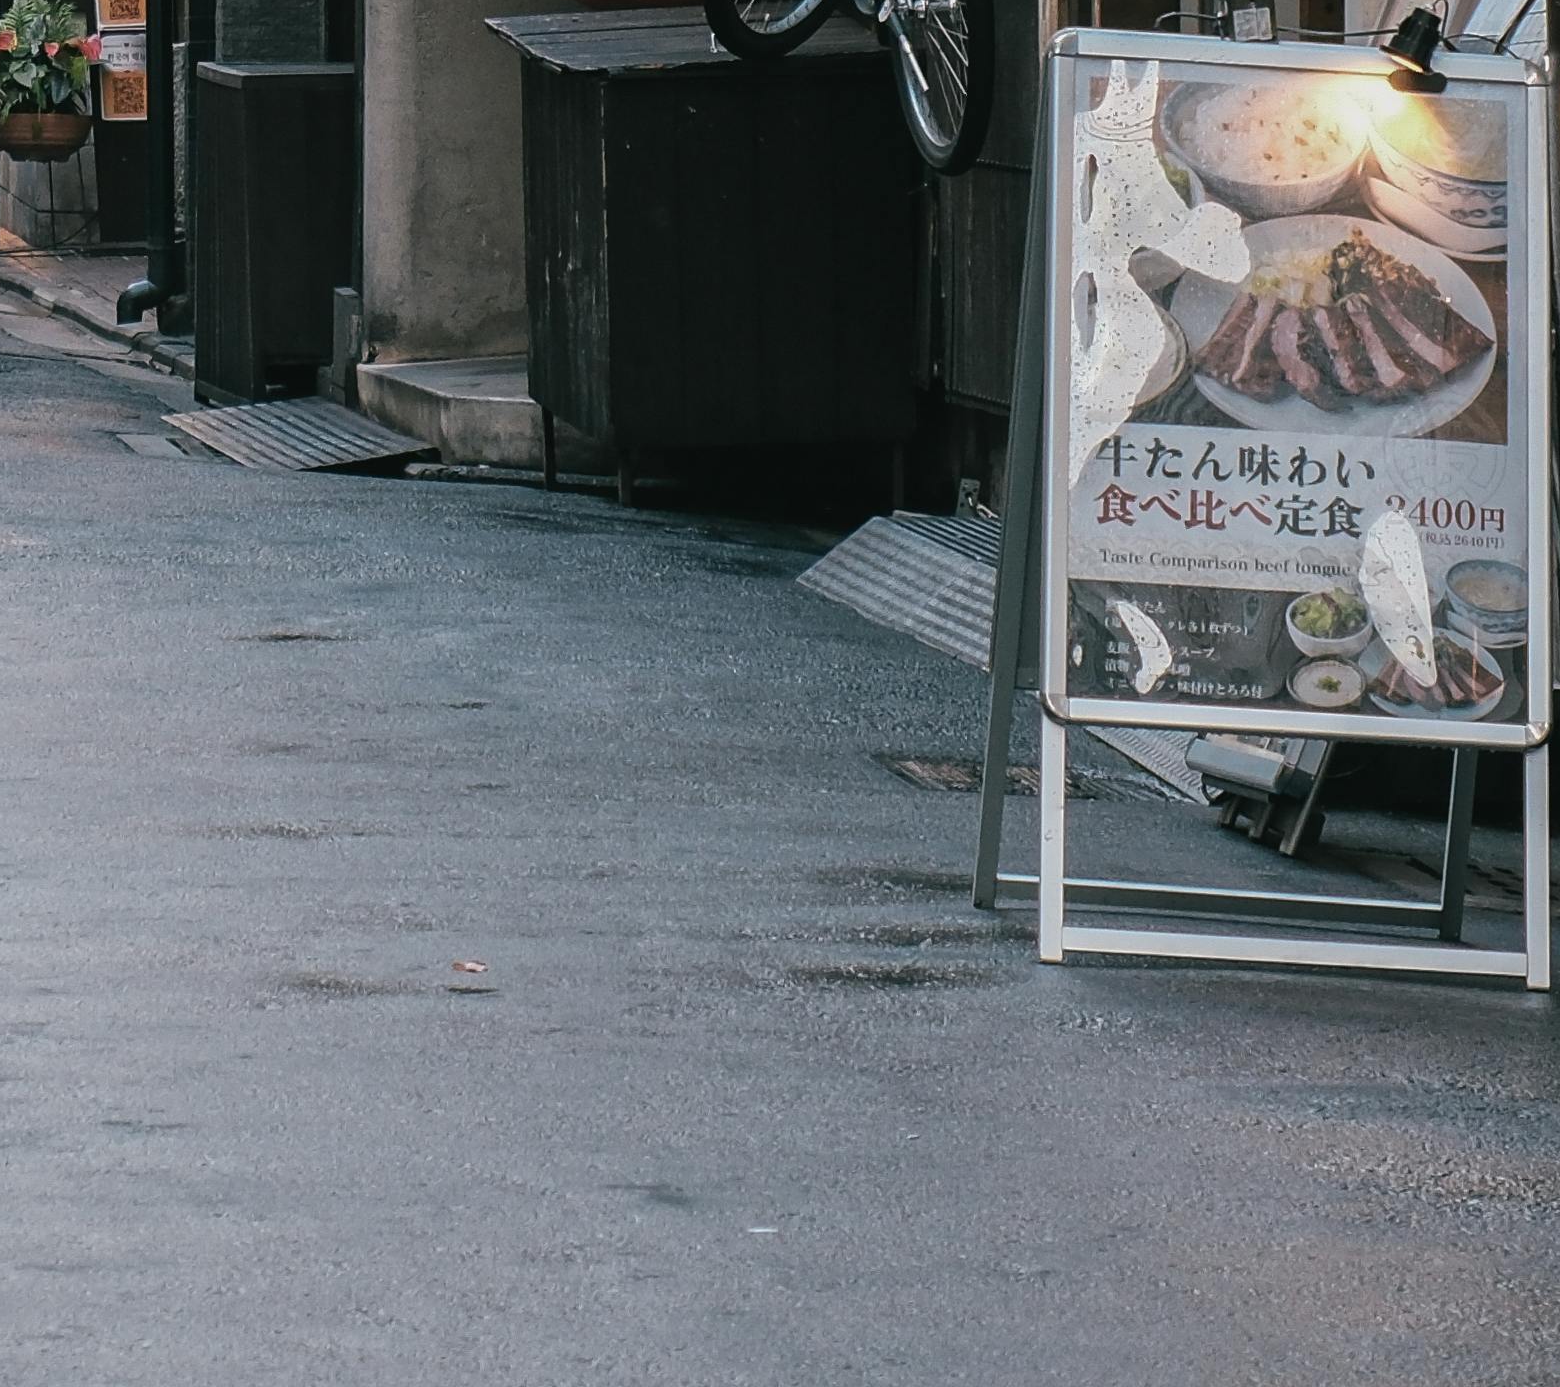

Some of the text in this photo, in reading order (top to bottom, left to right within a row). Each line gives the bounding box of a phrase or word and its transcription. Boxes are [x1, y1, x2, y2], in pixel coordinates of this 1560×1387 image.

[1096, 434, 1377, 489] 牛たん味わい
[1096, 483, 1366, 539] 食べ比べ定食
[1099, 548, 1144, 565] Taste
[1149, 551, 1249, 571] Comparison
[1254, 556, 1290, 575] beef
[1295, 559, 1351, 578] tongue
